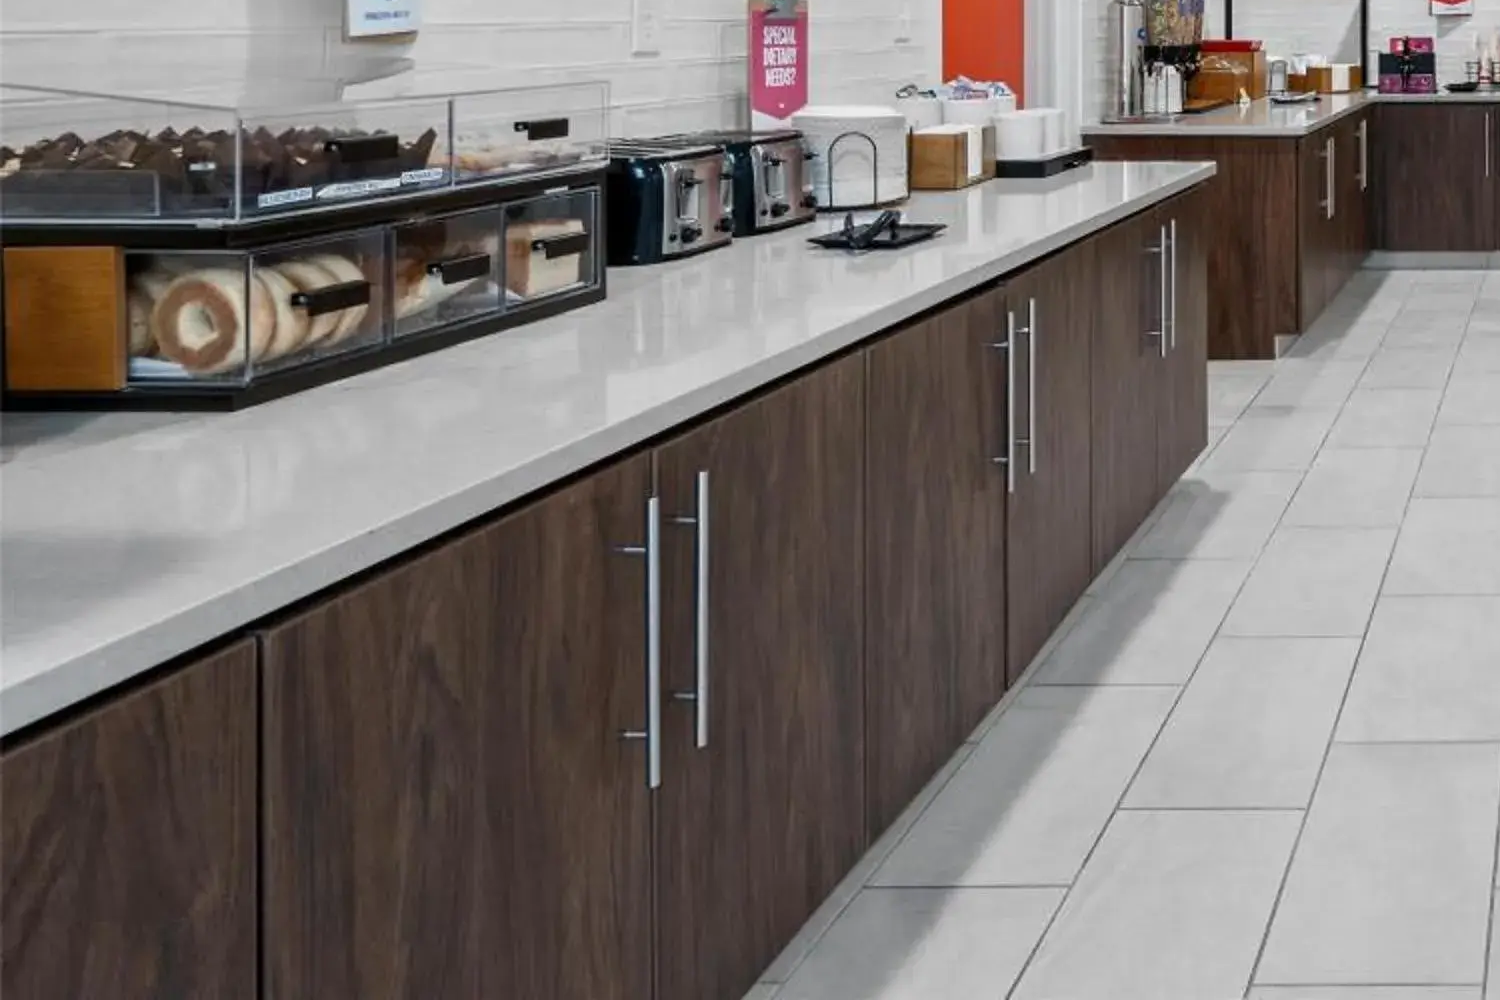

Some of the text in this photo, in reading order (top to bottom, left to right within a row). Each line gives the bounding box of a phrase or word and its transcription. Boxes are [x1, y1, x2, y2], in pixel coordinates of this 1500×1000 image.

[763, 26, 796, 45] SPECIAL
[763, 47, 797, 66] DIETARY
[765, 67, 797, 87] NEEDS?
